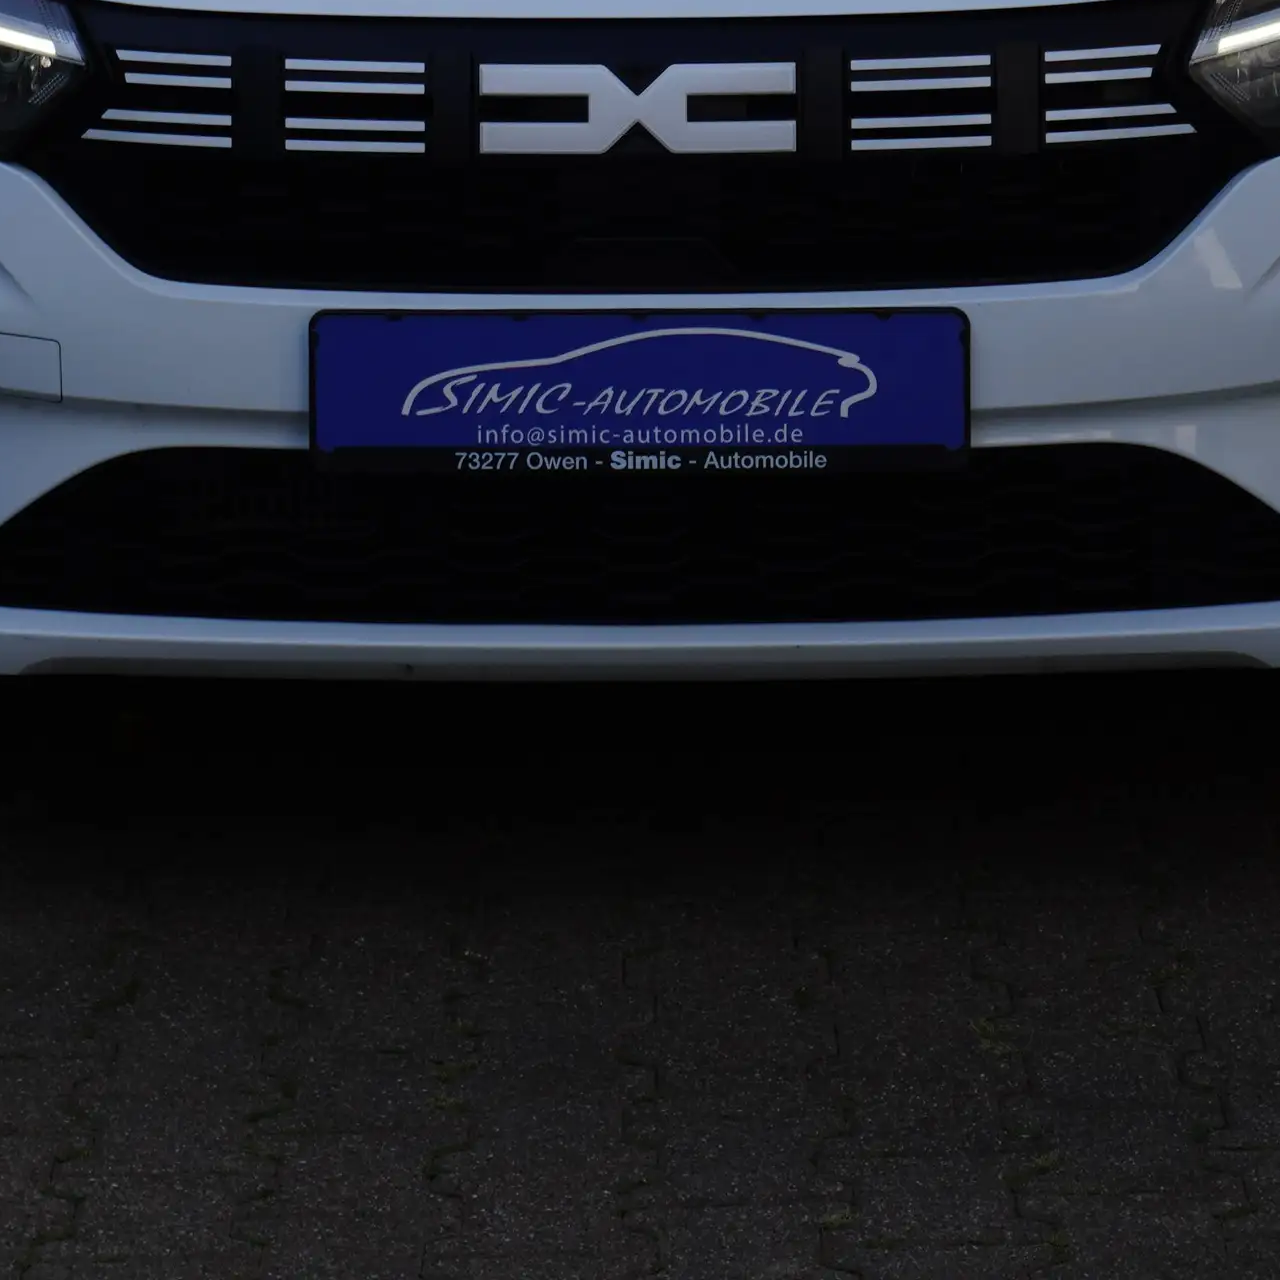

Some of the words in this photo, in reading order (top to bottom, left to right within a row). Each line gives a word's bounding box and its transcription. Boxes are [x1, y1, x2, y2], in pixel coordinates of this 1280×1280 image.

[415, 373, 841, 417] SIMIC-AUTOMOBILE
[477, 423, 804, 446] info@simic-automobile.de
[454, 451, 520, 471] 73277
[526, 452, 588, 471] Owen
[610, 449, 682, 471] Simic
[703, 449, 828, 470] Automobile
